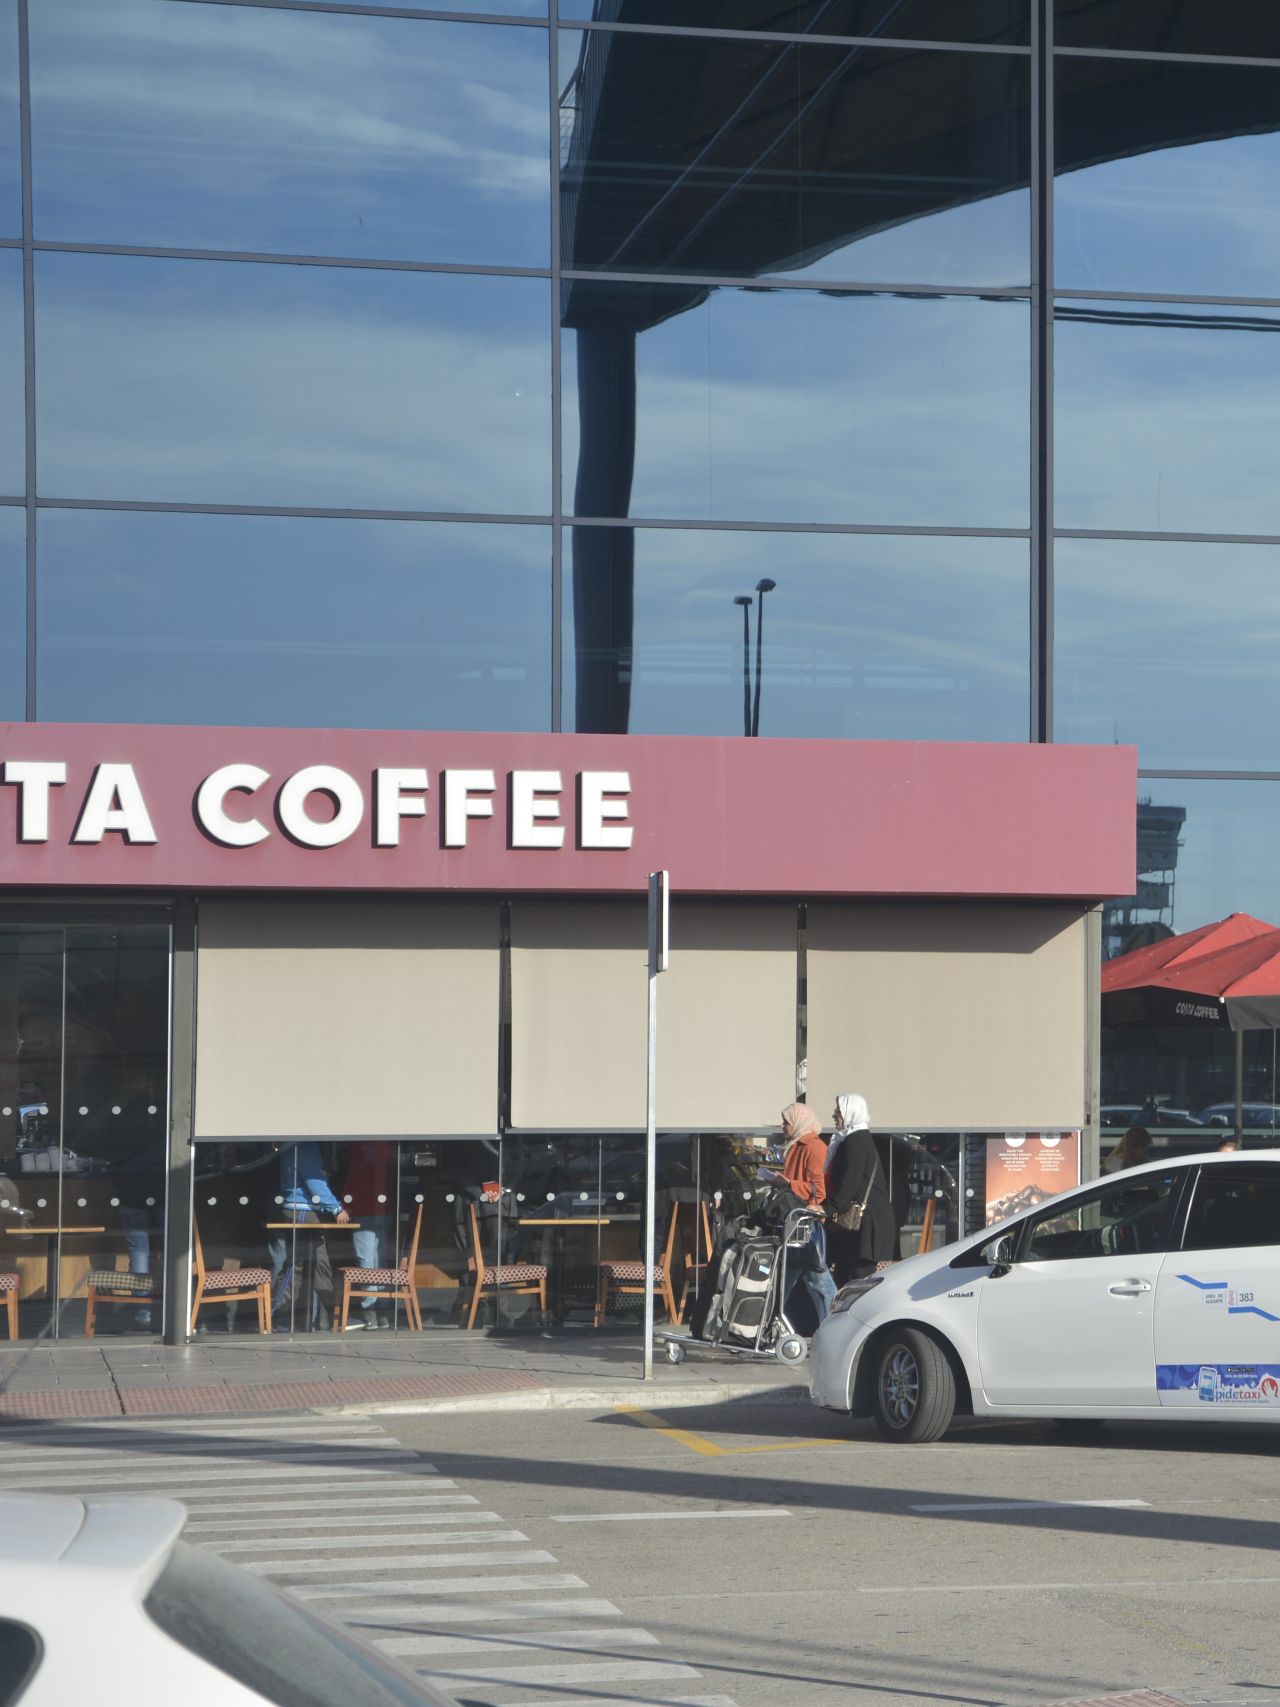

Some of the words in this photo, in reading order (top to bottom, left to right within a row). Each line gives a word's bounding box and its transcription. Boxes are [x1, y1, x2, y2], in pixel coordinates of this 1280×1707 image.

[3, 760, 158, 845] TA
[192, 763, 634, 851] COFFEE
[1175, 1002, 1195, 1017] COSTA
[1193, 1005, 1221, 1020] COFFEE
[1239, 1293, 1254, 1302] 383
[1215, 1387, 1261, 1403] pidetaxi
